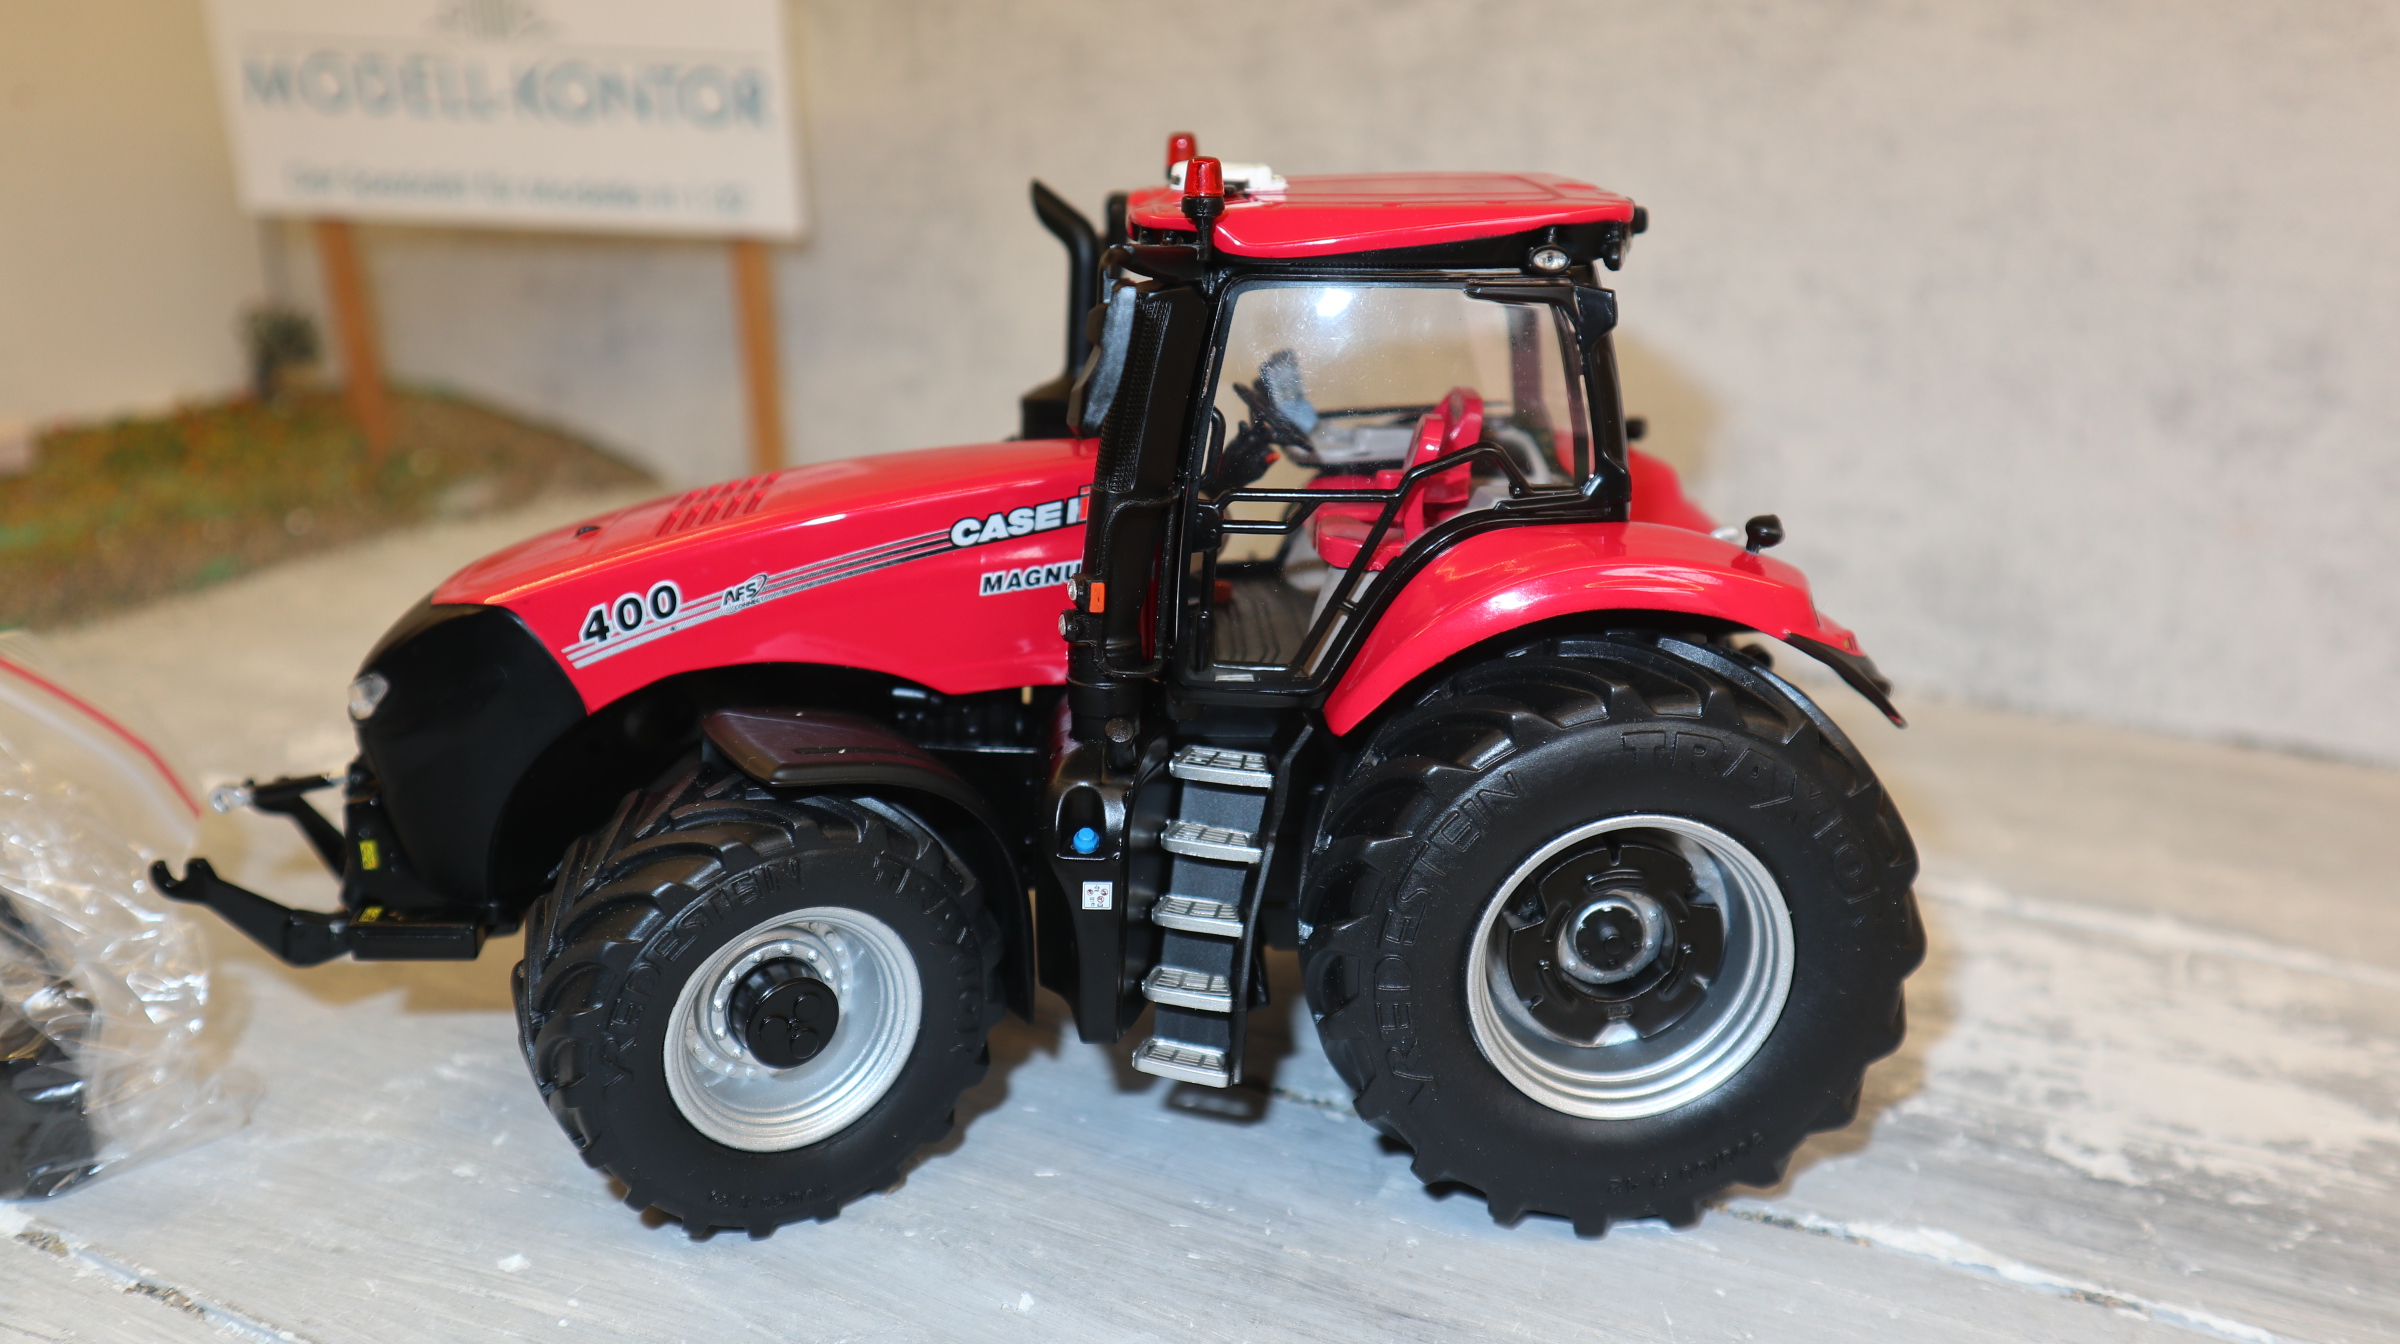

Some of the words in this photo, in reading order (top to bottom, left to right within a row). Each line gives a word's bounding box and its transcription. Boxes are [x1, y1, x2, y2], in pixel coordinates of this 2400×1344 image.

[950, 500, 1063, 548] CASE
[723, 582, 757, 606] AFS
[980, 561, 1082, 594] MAGNU
[581, 583, 679, 643] 400
[1375, 771, 1524, 1104] VREDESTEIN
